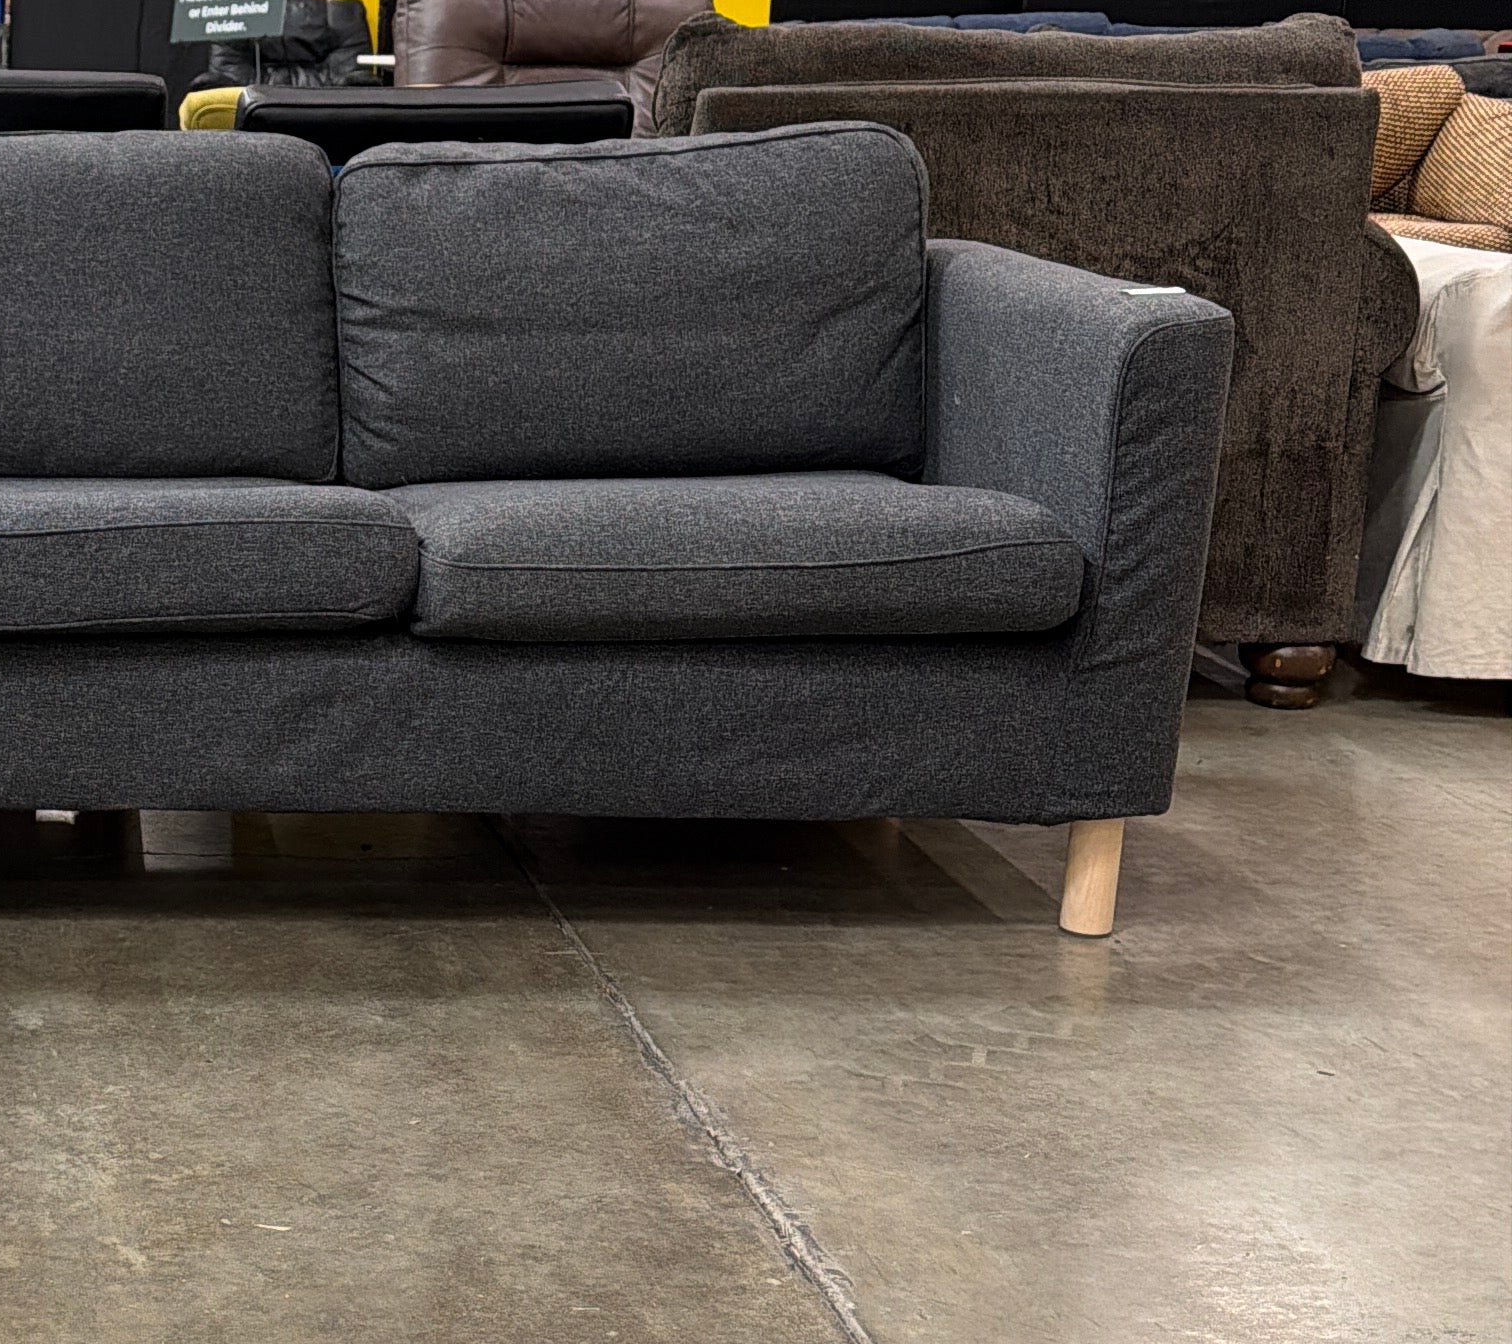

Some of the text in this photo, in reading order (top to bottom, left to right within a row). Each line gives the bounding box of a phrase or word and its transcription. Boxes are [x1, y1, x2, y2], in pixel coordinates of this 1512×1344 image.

[188, 0, 268, 19] or Enter Behind
[205, 19, 247, 34] Divider.
